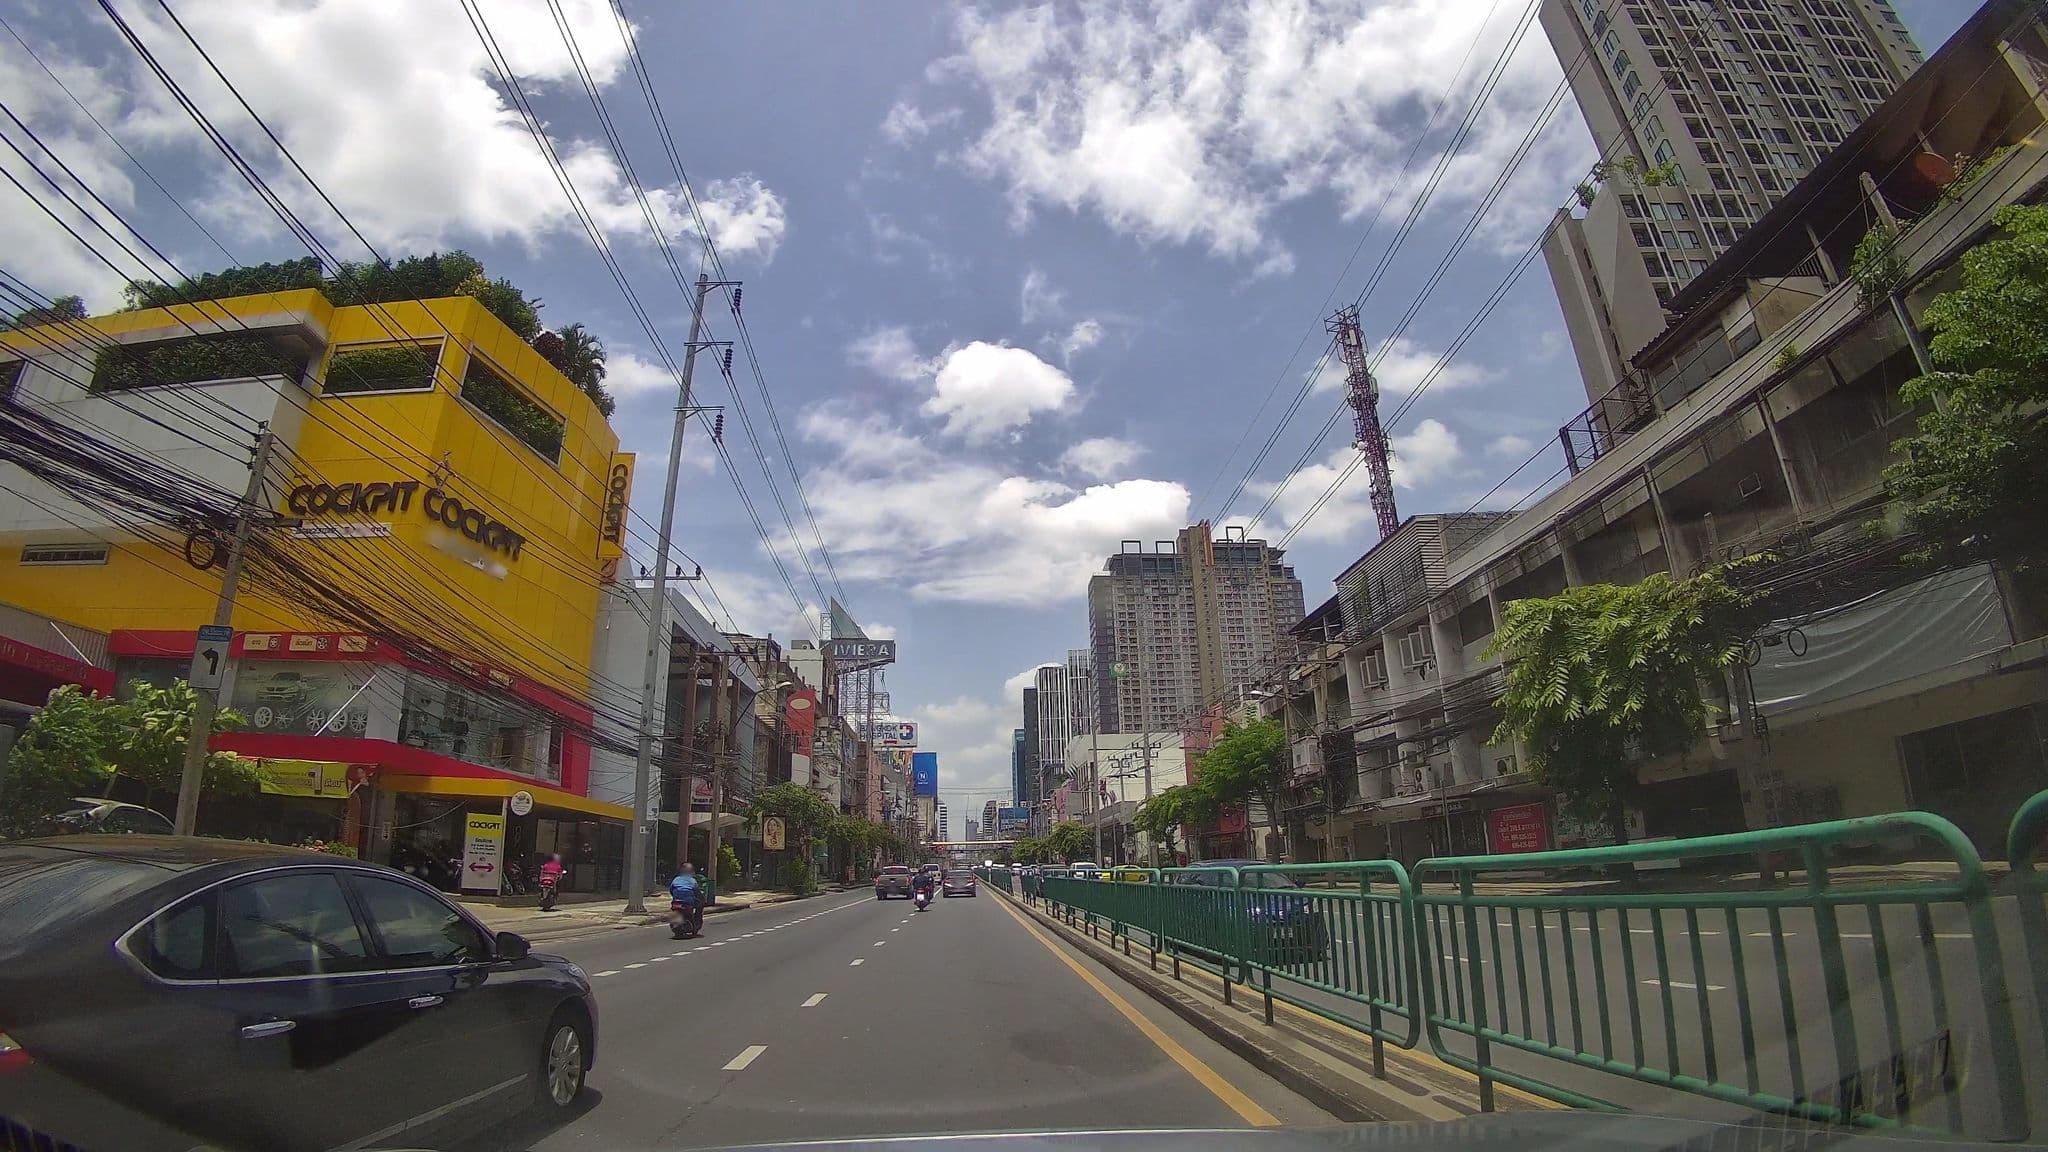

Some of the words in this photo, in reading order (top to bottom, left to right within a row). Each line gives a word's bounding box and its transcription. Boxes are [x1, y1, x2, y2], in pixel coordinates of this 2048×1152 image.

[288, 481, 420, 515] COCKPIT
[603, 463, 628, 543] COCKPIT
[423, 487, 526, 562] COCKPIT
[834, 643, 890, 657] IVIERA
[469, 821, 501, 830] COCKPIT
